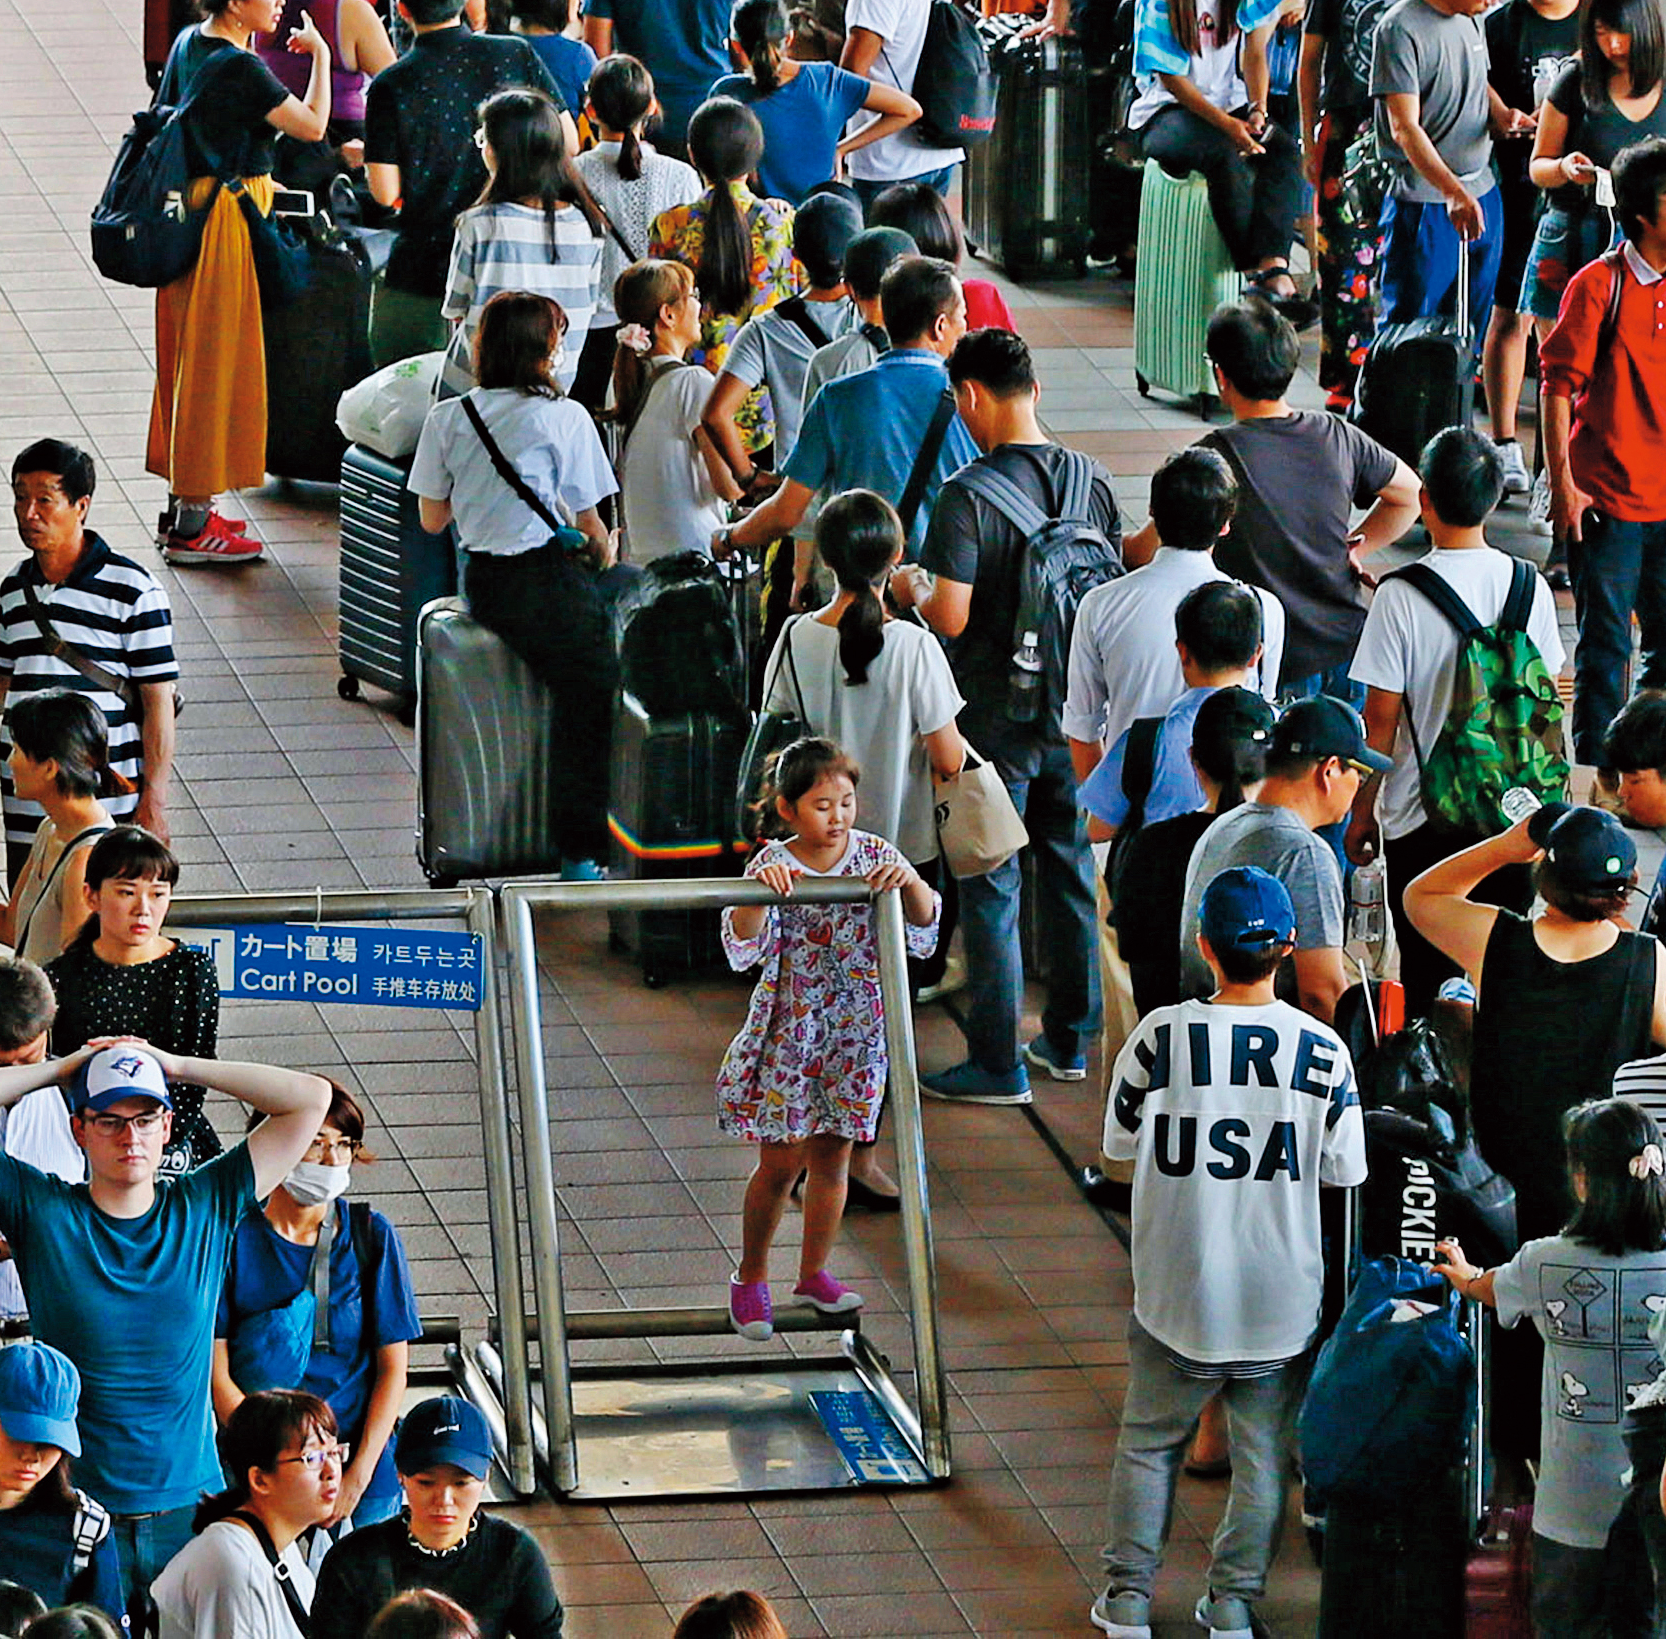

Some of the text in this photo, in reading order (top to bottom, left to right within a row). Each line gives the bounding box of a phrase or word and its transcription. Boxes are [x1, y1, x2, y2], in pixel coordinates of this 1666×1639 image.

[241, 932, 356, 963] カート置場
[241, 968, 358, 996] Cart Pool
[372, 977, 476, 1003] 手推车存放处
[1154, 1114, 1301, 1182] USA
